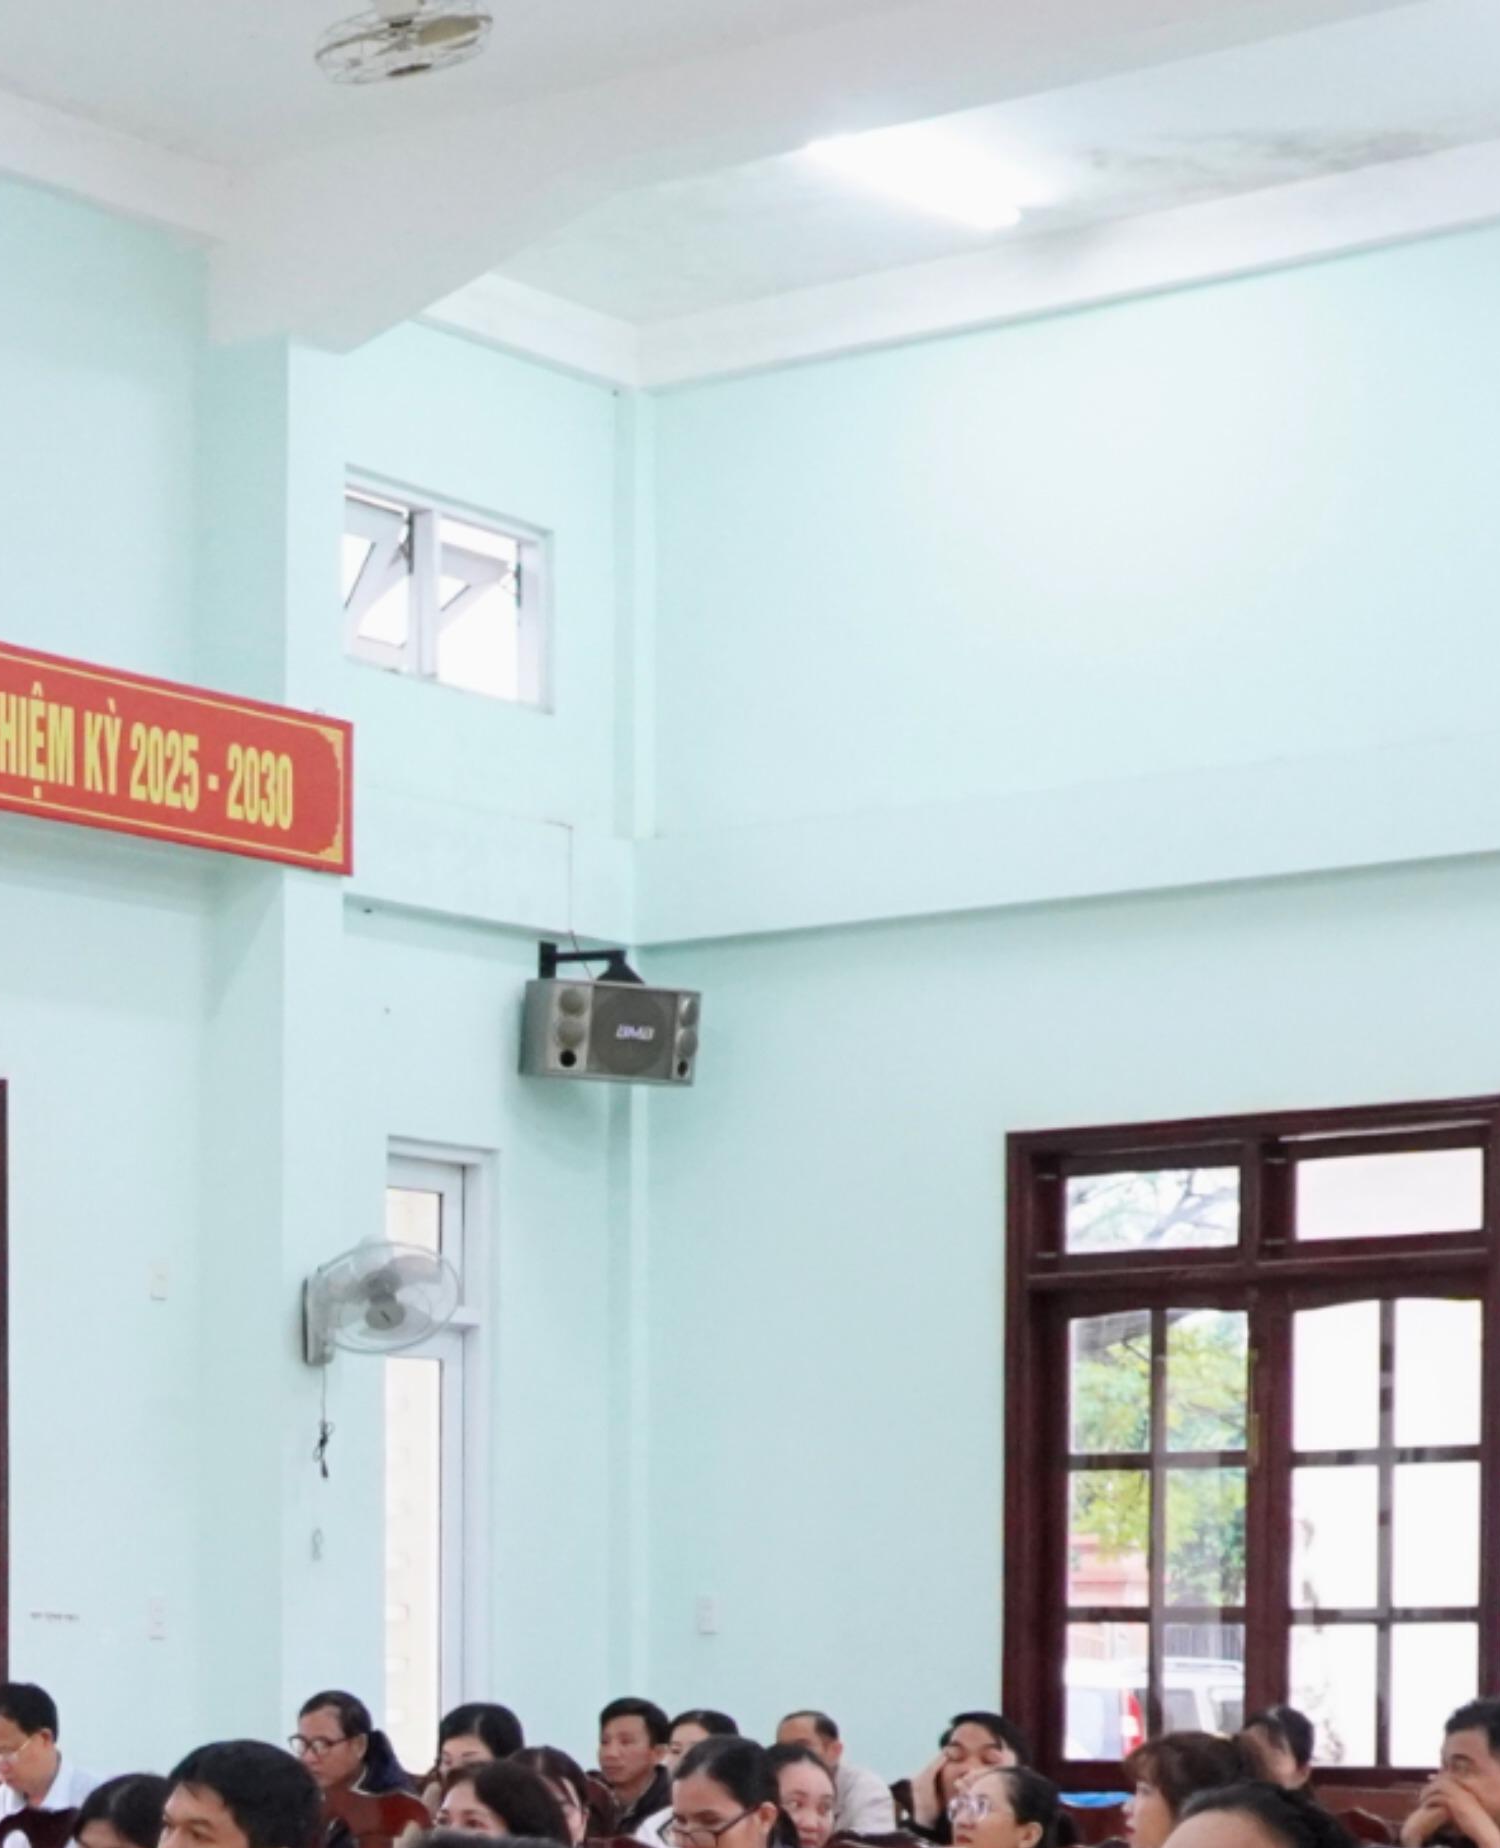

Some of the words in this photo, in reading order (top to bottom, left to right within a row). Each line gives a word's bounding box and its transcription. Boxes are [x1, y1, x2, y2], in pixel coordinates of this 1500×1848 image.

[84, 698, 123, 796] KỲ
[129, 722, 201, 813] 2025
[227, 744, 294, 830] 2030
